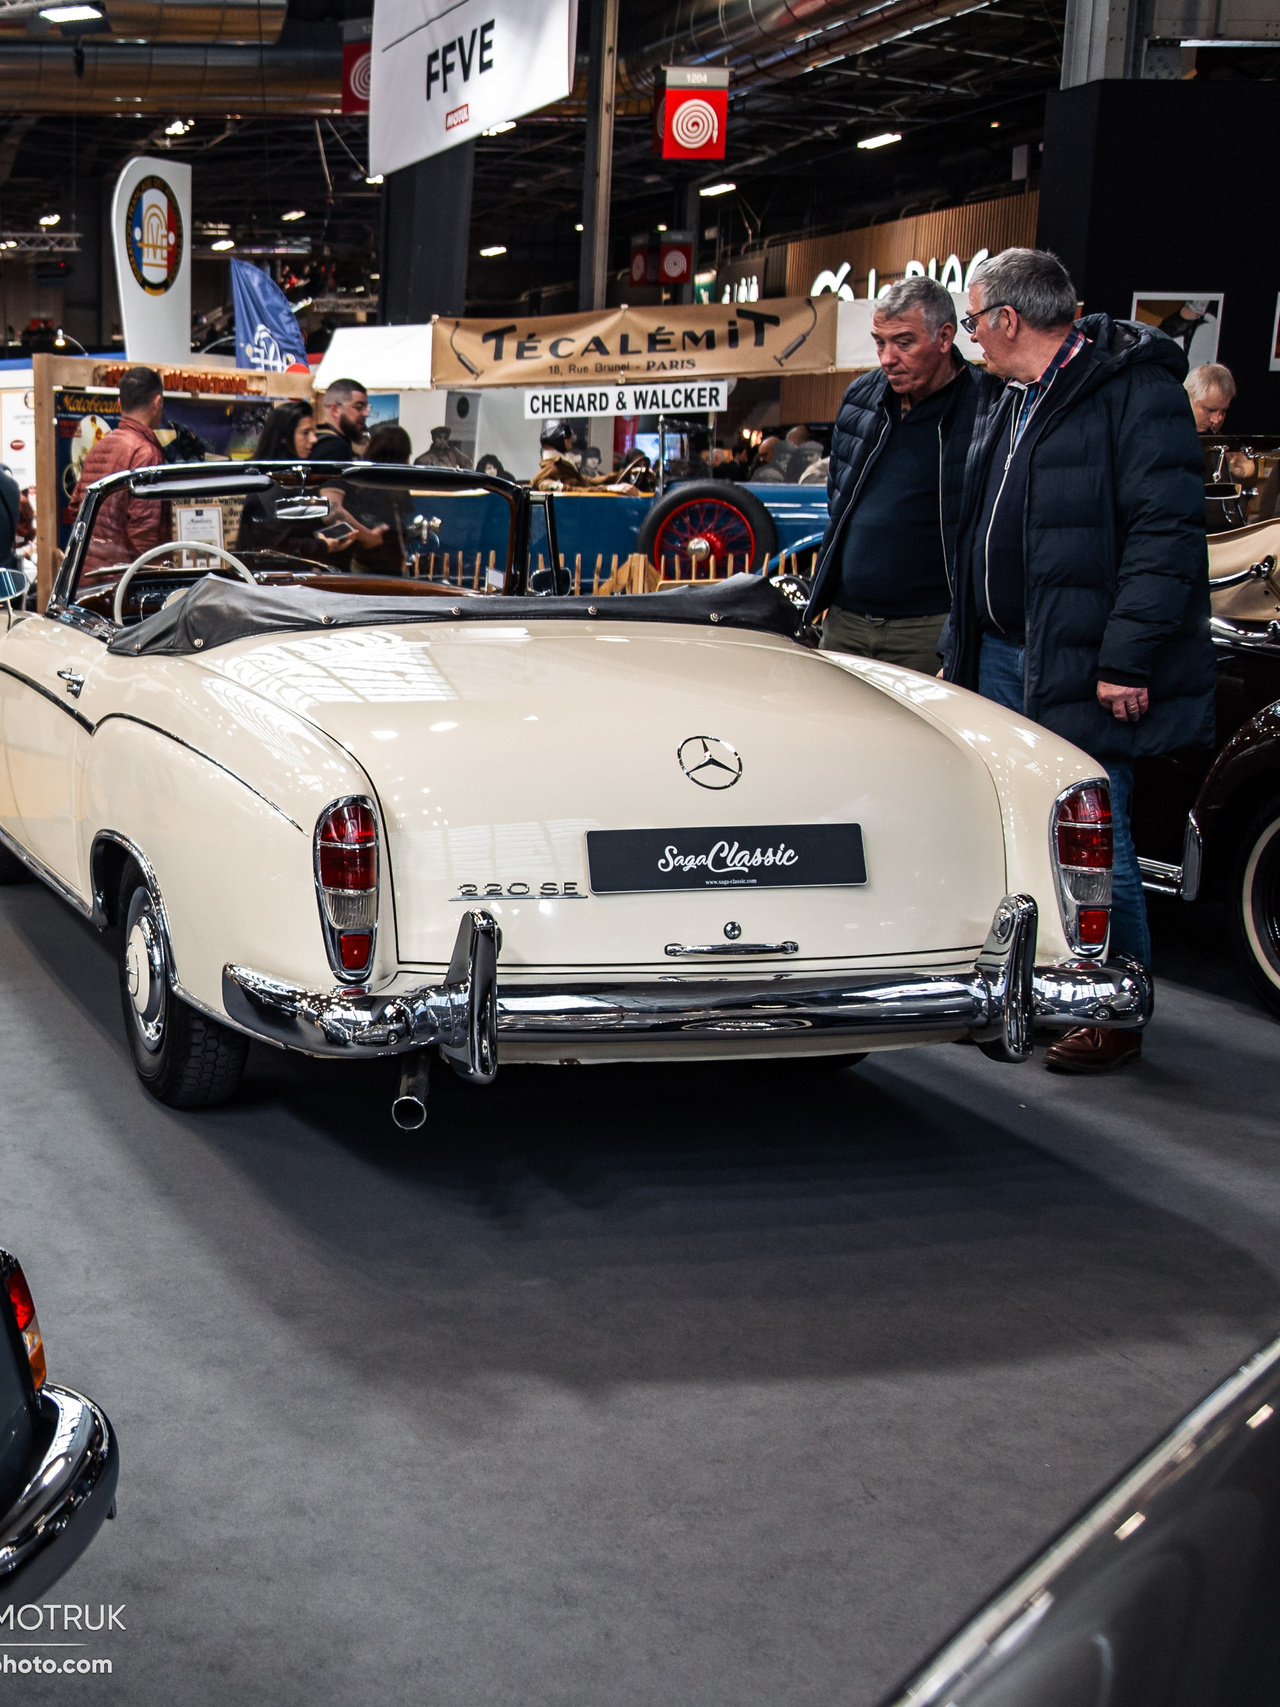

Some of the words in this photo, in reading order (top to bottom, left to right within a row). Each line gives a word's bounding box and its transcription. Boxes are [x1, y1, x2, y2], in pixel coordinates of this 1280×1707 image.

[426, 18, 495, 102] FFVE
[686, 73, 708, 84] 1204
[447, 106, 469, 128] MOTUL
[549, 365, 563, 376] 18,
[569, 363, 589, 374] Rue
[646, 358, 696, 371] PARIS
[530, 391, 610, 414] CHENARD
[615, 391, 627, 411] &
[633, 387, 721, 410] WALCKER
[457, 882, 531, 897] 220
[539, 882, 579, 896] SE
[705, 878, 757, 886] www.saga-classic.com
